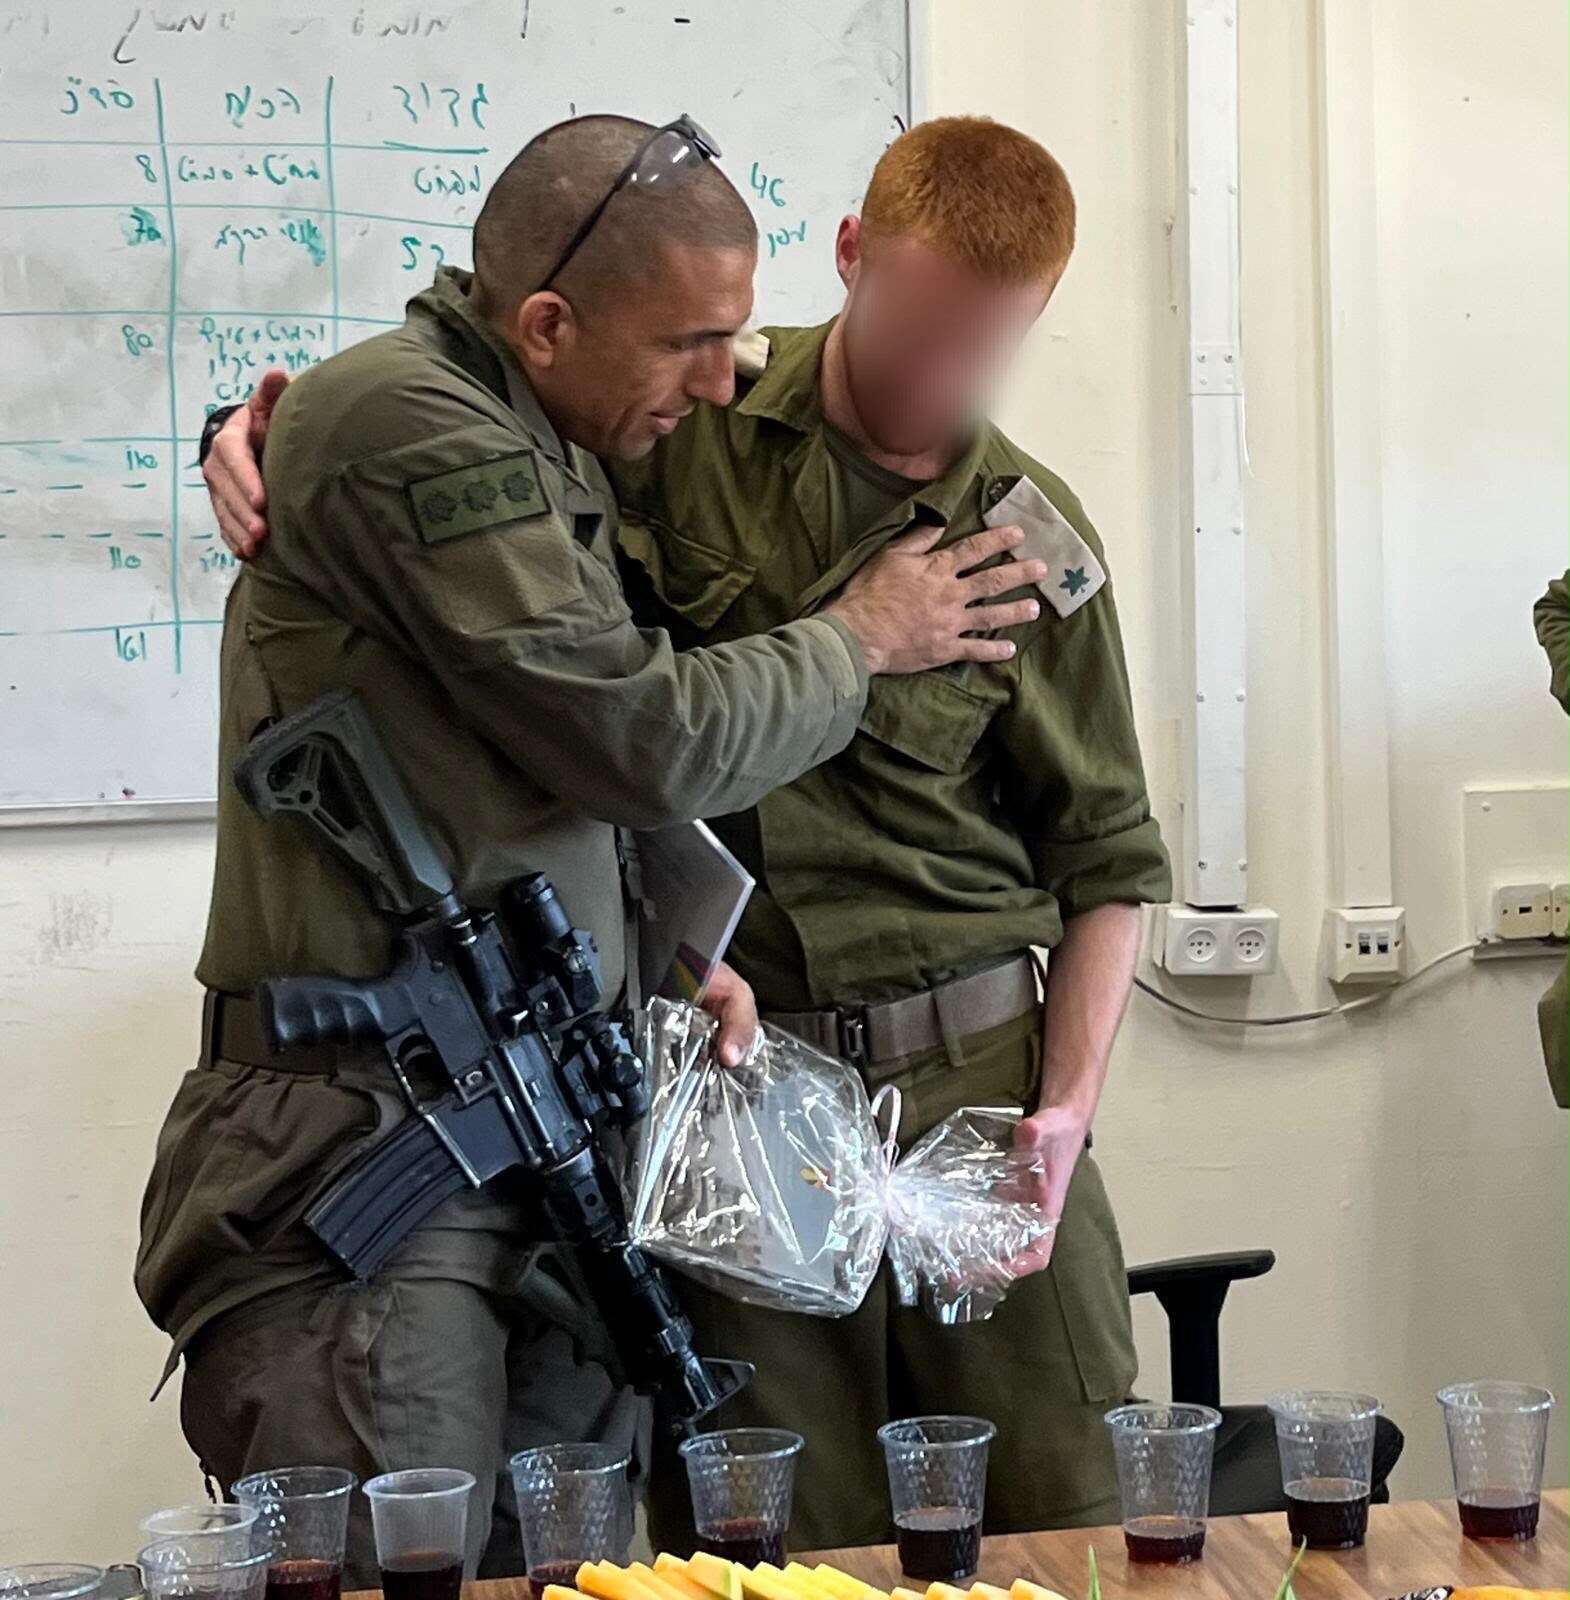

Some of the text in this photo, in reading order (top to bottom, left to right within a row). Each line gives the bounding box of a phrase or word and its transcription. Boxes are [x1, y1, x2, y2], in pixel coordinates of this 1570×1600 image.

[391, 82, 489, 130] גדוד
[136, 154, 157, 183] 8
[749, 161, 787, 208] 46
[122, 323, 154, 357] 80
[115, 627, 147, 662] 161
